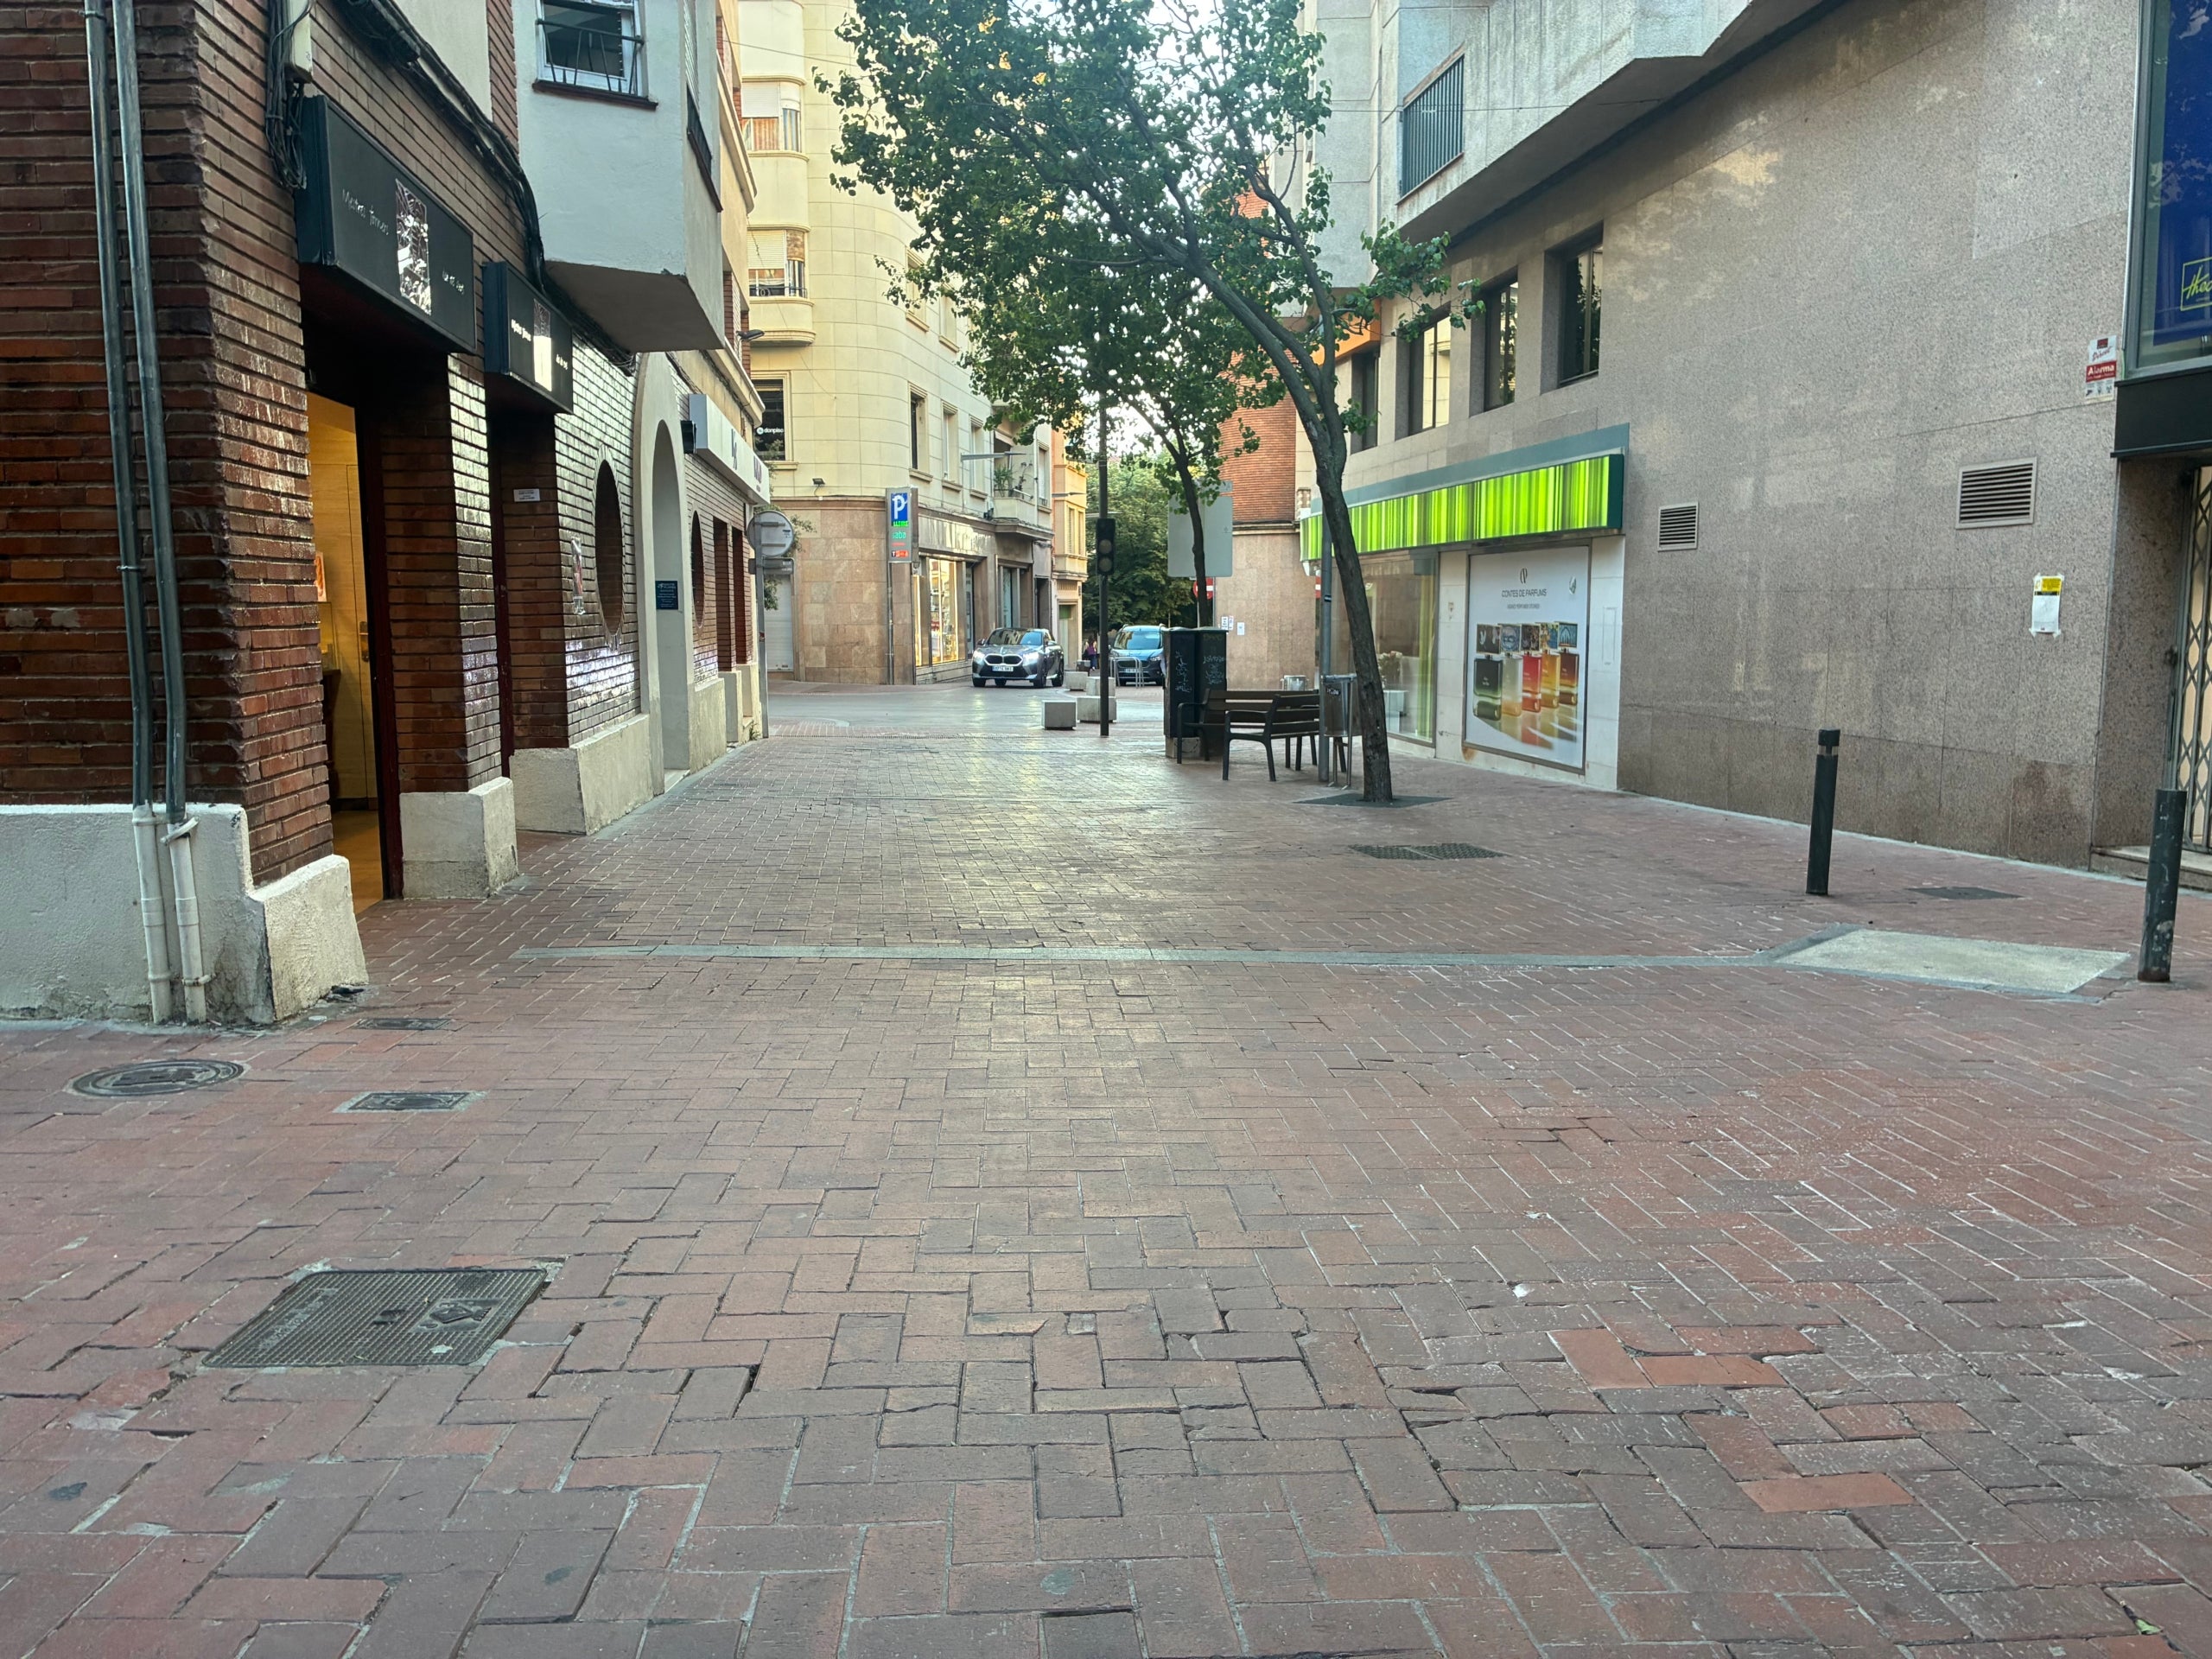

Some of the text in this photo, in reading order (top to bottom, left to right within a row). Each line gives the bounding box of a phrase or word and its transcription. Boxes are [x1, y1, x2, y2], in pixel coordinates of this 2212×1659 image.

[2088, 365, 2115, 376] Alarma
[892, 495, 907, 520] P
[1502, 589, 1518, 598] CONTES
[1526, 588, 1548, 597] PARFUMS
